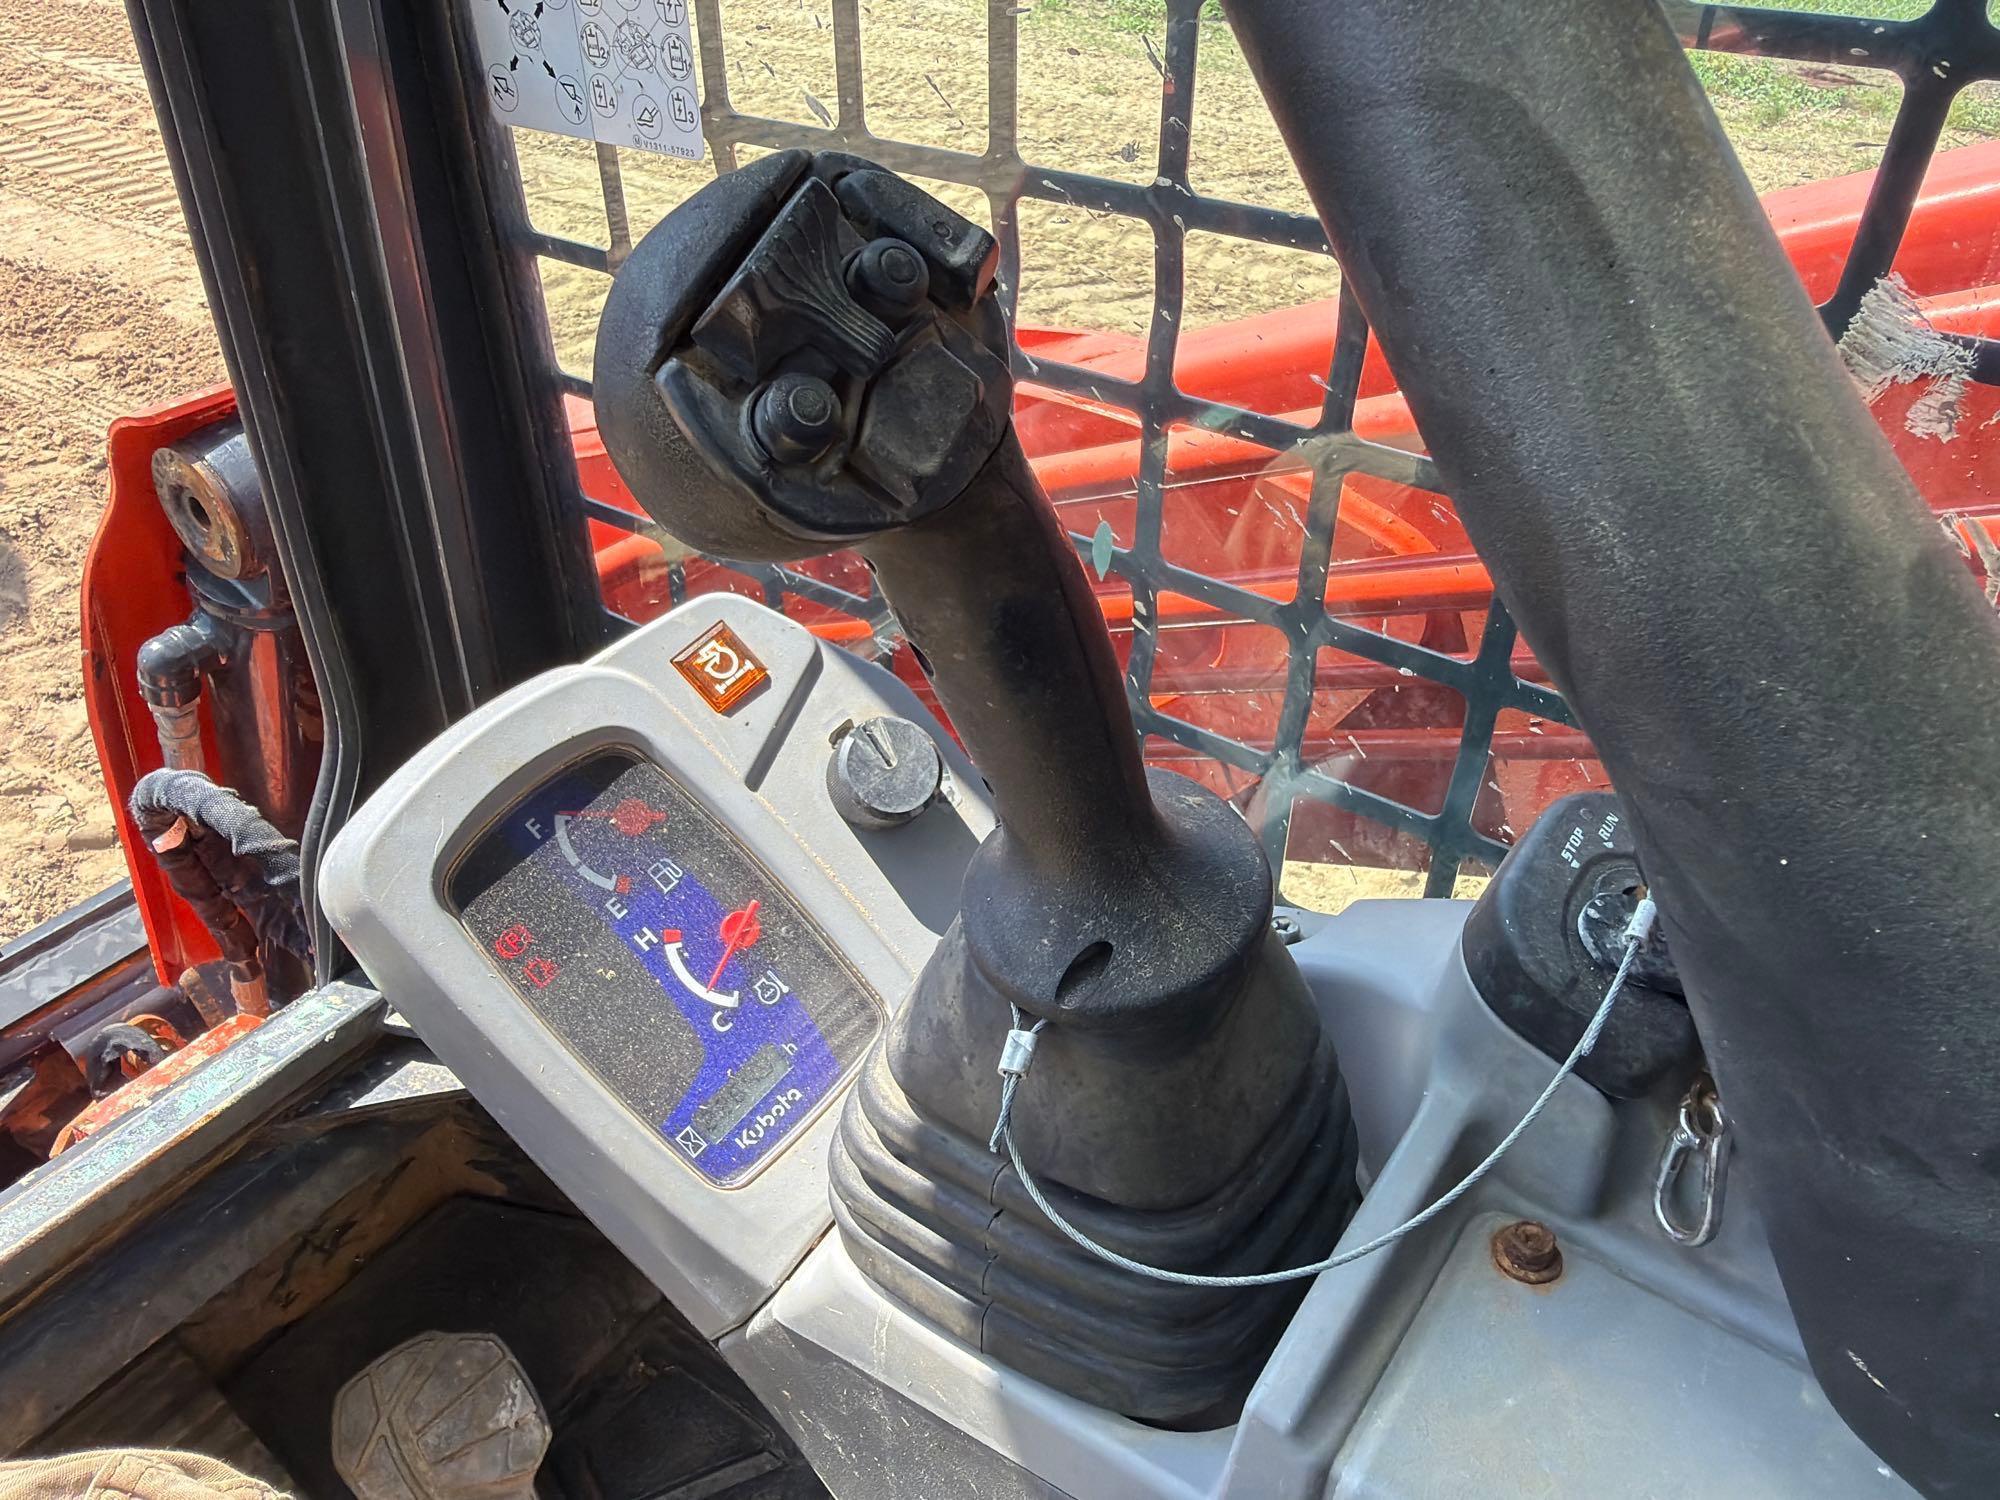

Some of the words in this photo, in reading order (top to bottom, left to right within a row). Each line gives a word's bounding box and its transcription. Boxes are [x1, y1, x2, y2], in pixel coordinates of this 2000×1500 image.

[609, 97, 616, 108] 4
[688, 112, 695, 123] 3
[643, 141, 696, 157] V1311-57923
[525, 818, 542, 840] F
[1598, 812, 1620, 840] RUN
[1560, 827, 1585, 862] STOP
[606, 898, 628, 920] E
[634, 927, 658, 951] H
[712, 1012, 733, 1033] C
[782, 1042, 798, 1056] h
[735, 1088, 803, 1149] Kubota
